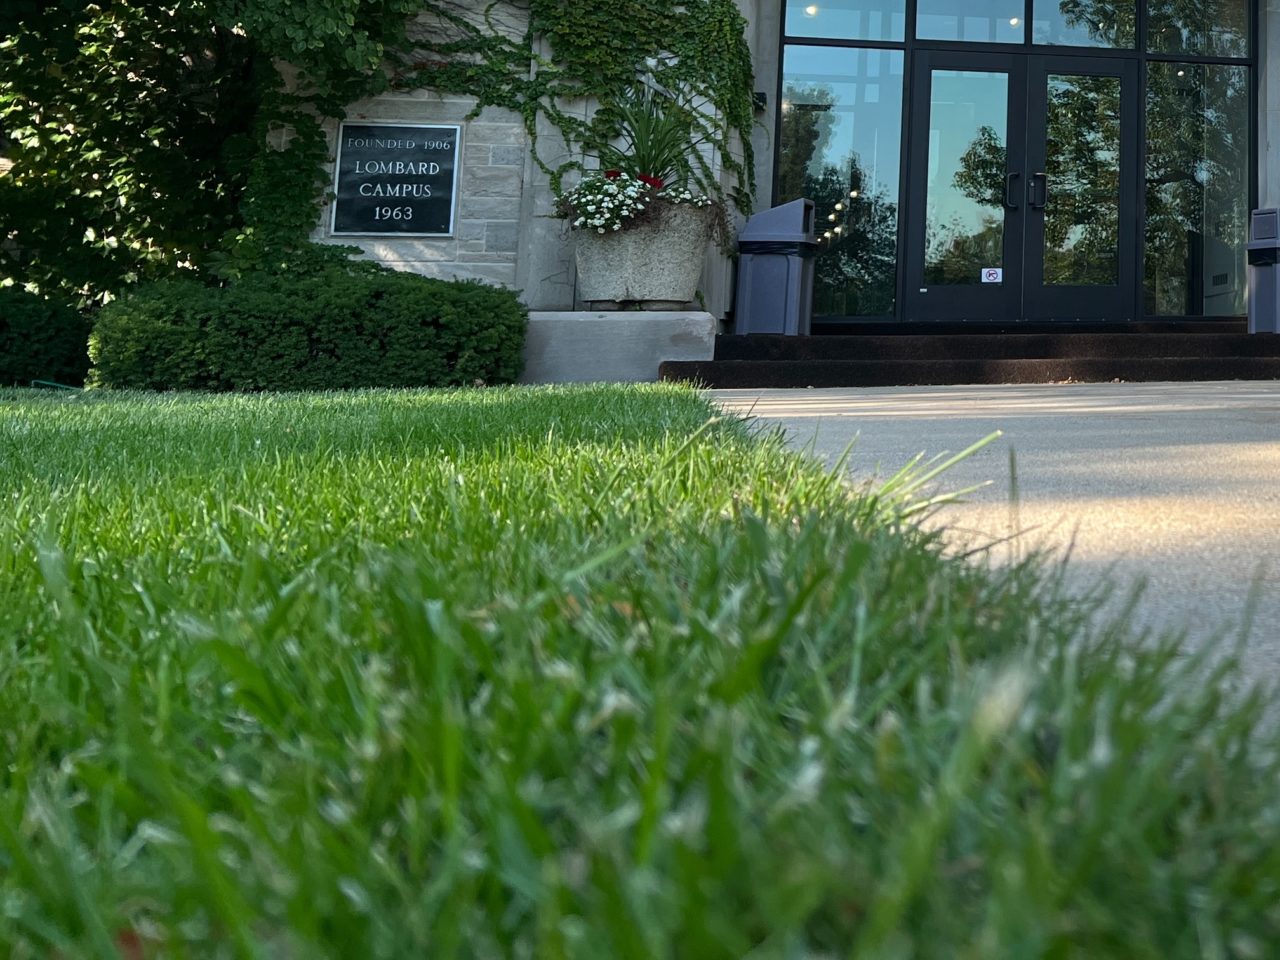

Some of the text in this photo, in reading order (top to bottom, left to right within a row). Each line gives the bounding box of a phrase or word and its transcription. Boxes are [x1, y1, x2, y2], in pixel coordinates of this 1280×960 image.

[348, 138, 450, 150] FOUNDED 1906
[355, 160, 440, 175] LOMBARD
[359, 183, 432, 197] CAMPUS
[374, 206, 413, 220] 1963
